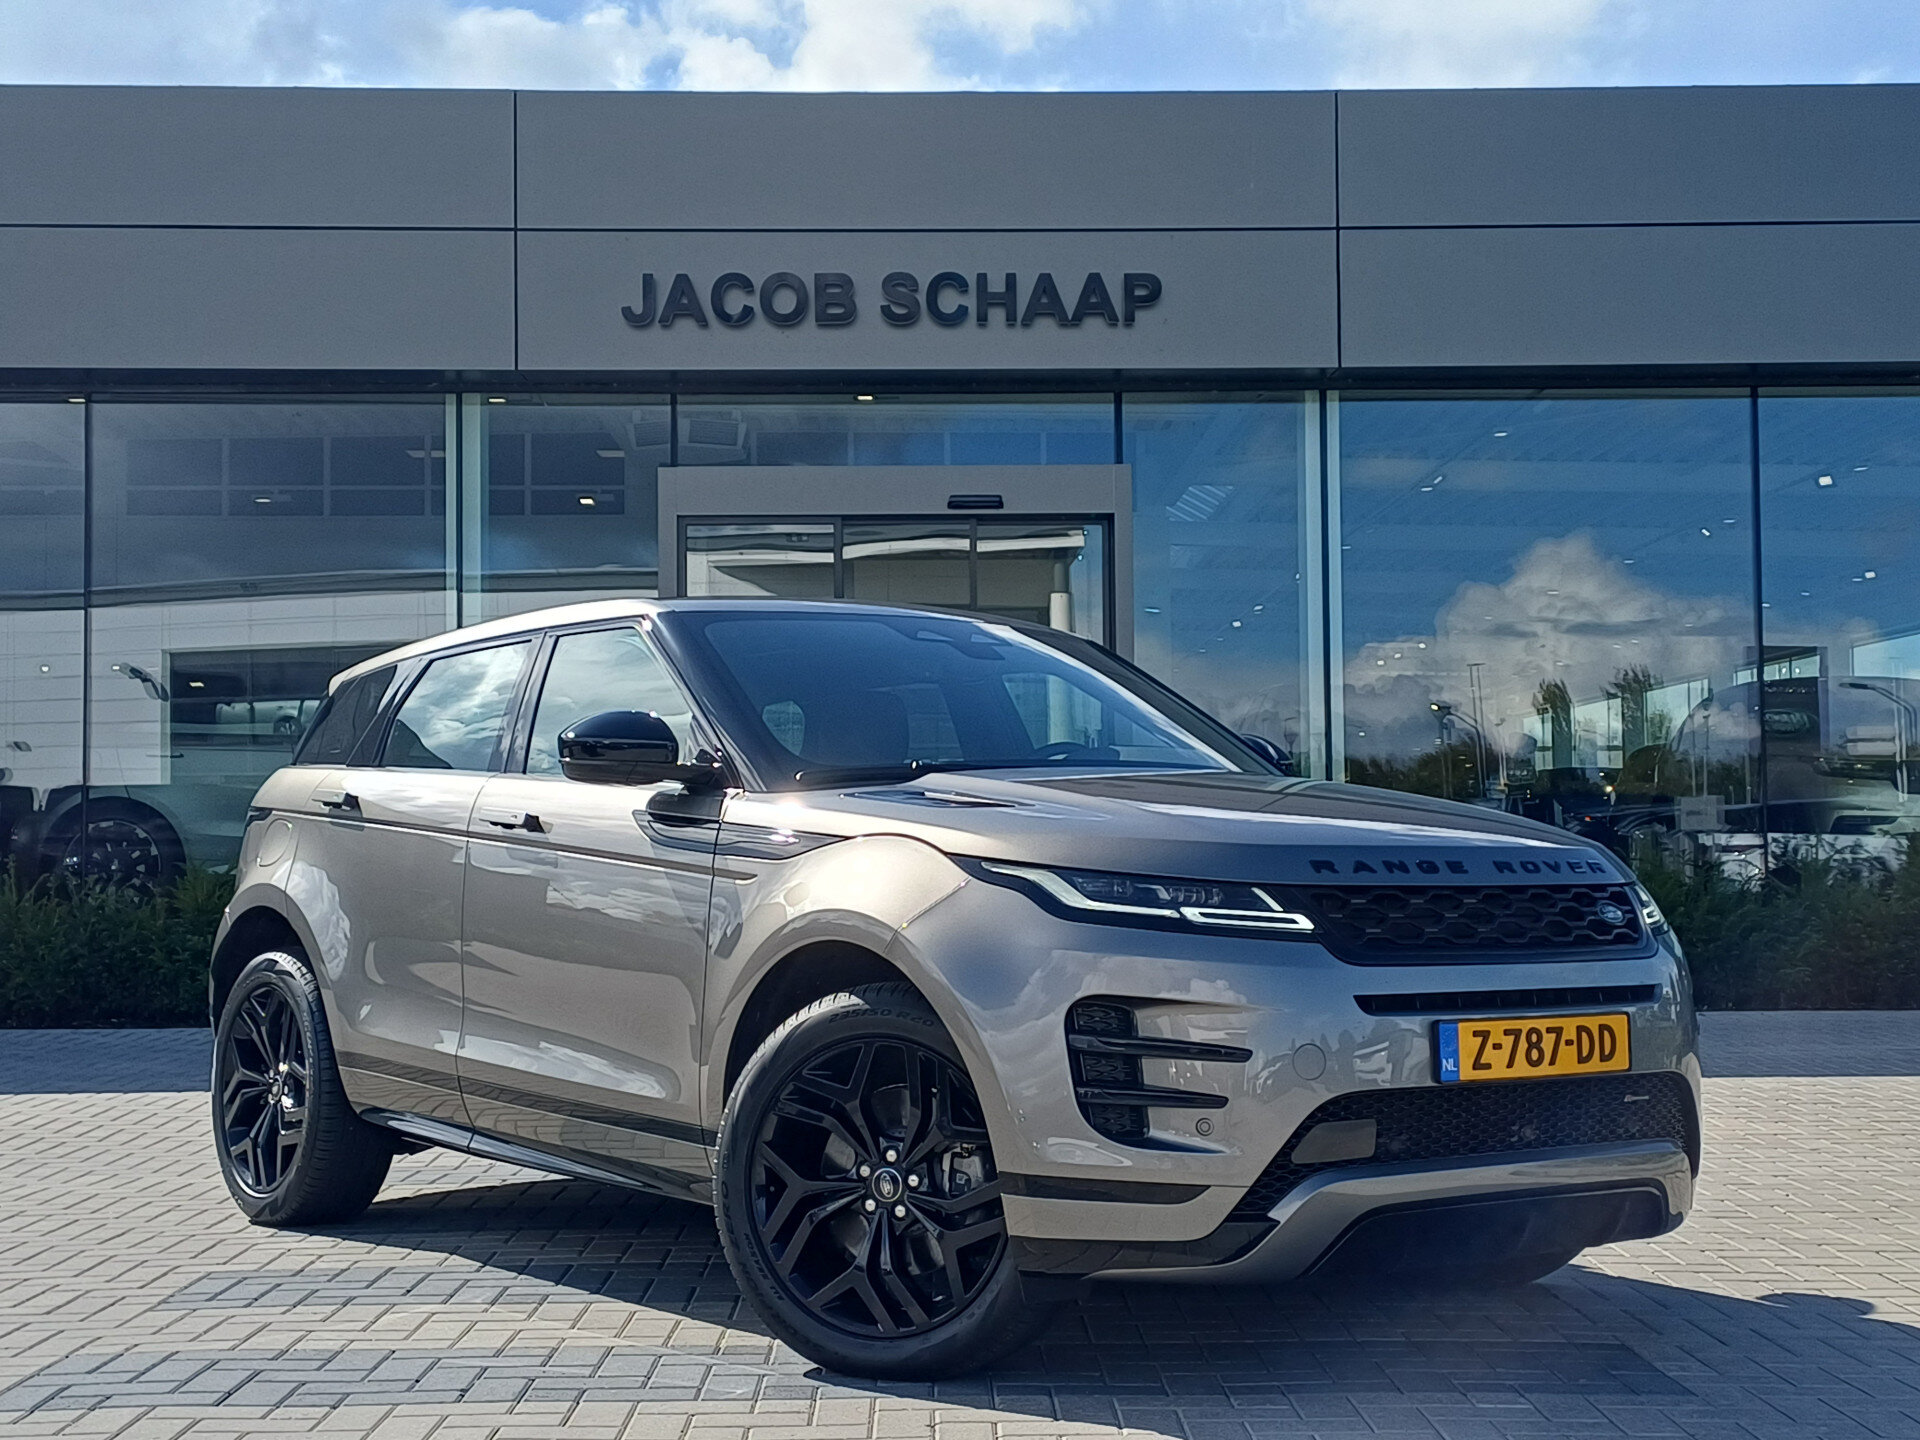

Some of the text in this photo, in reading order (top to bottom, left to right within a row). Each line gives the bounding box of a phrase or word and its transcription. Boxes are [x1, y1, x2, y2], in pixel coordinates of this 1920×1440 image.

[621, 271, 1162, 328] JACOB SCHAAP
[1309, 859, 1606, 874] RANGE ROVER
[1472, 1023, 1617, 1070] Z-787-DD
[1441, 1058, 1457, 1071] NL
